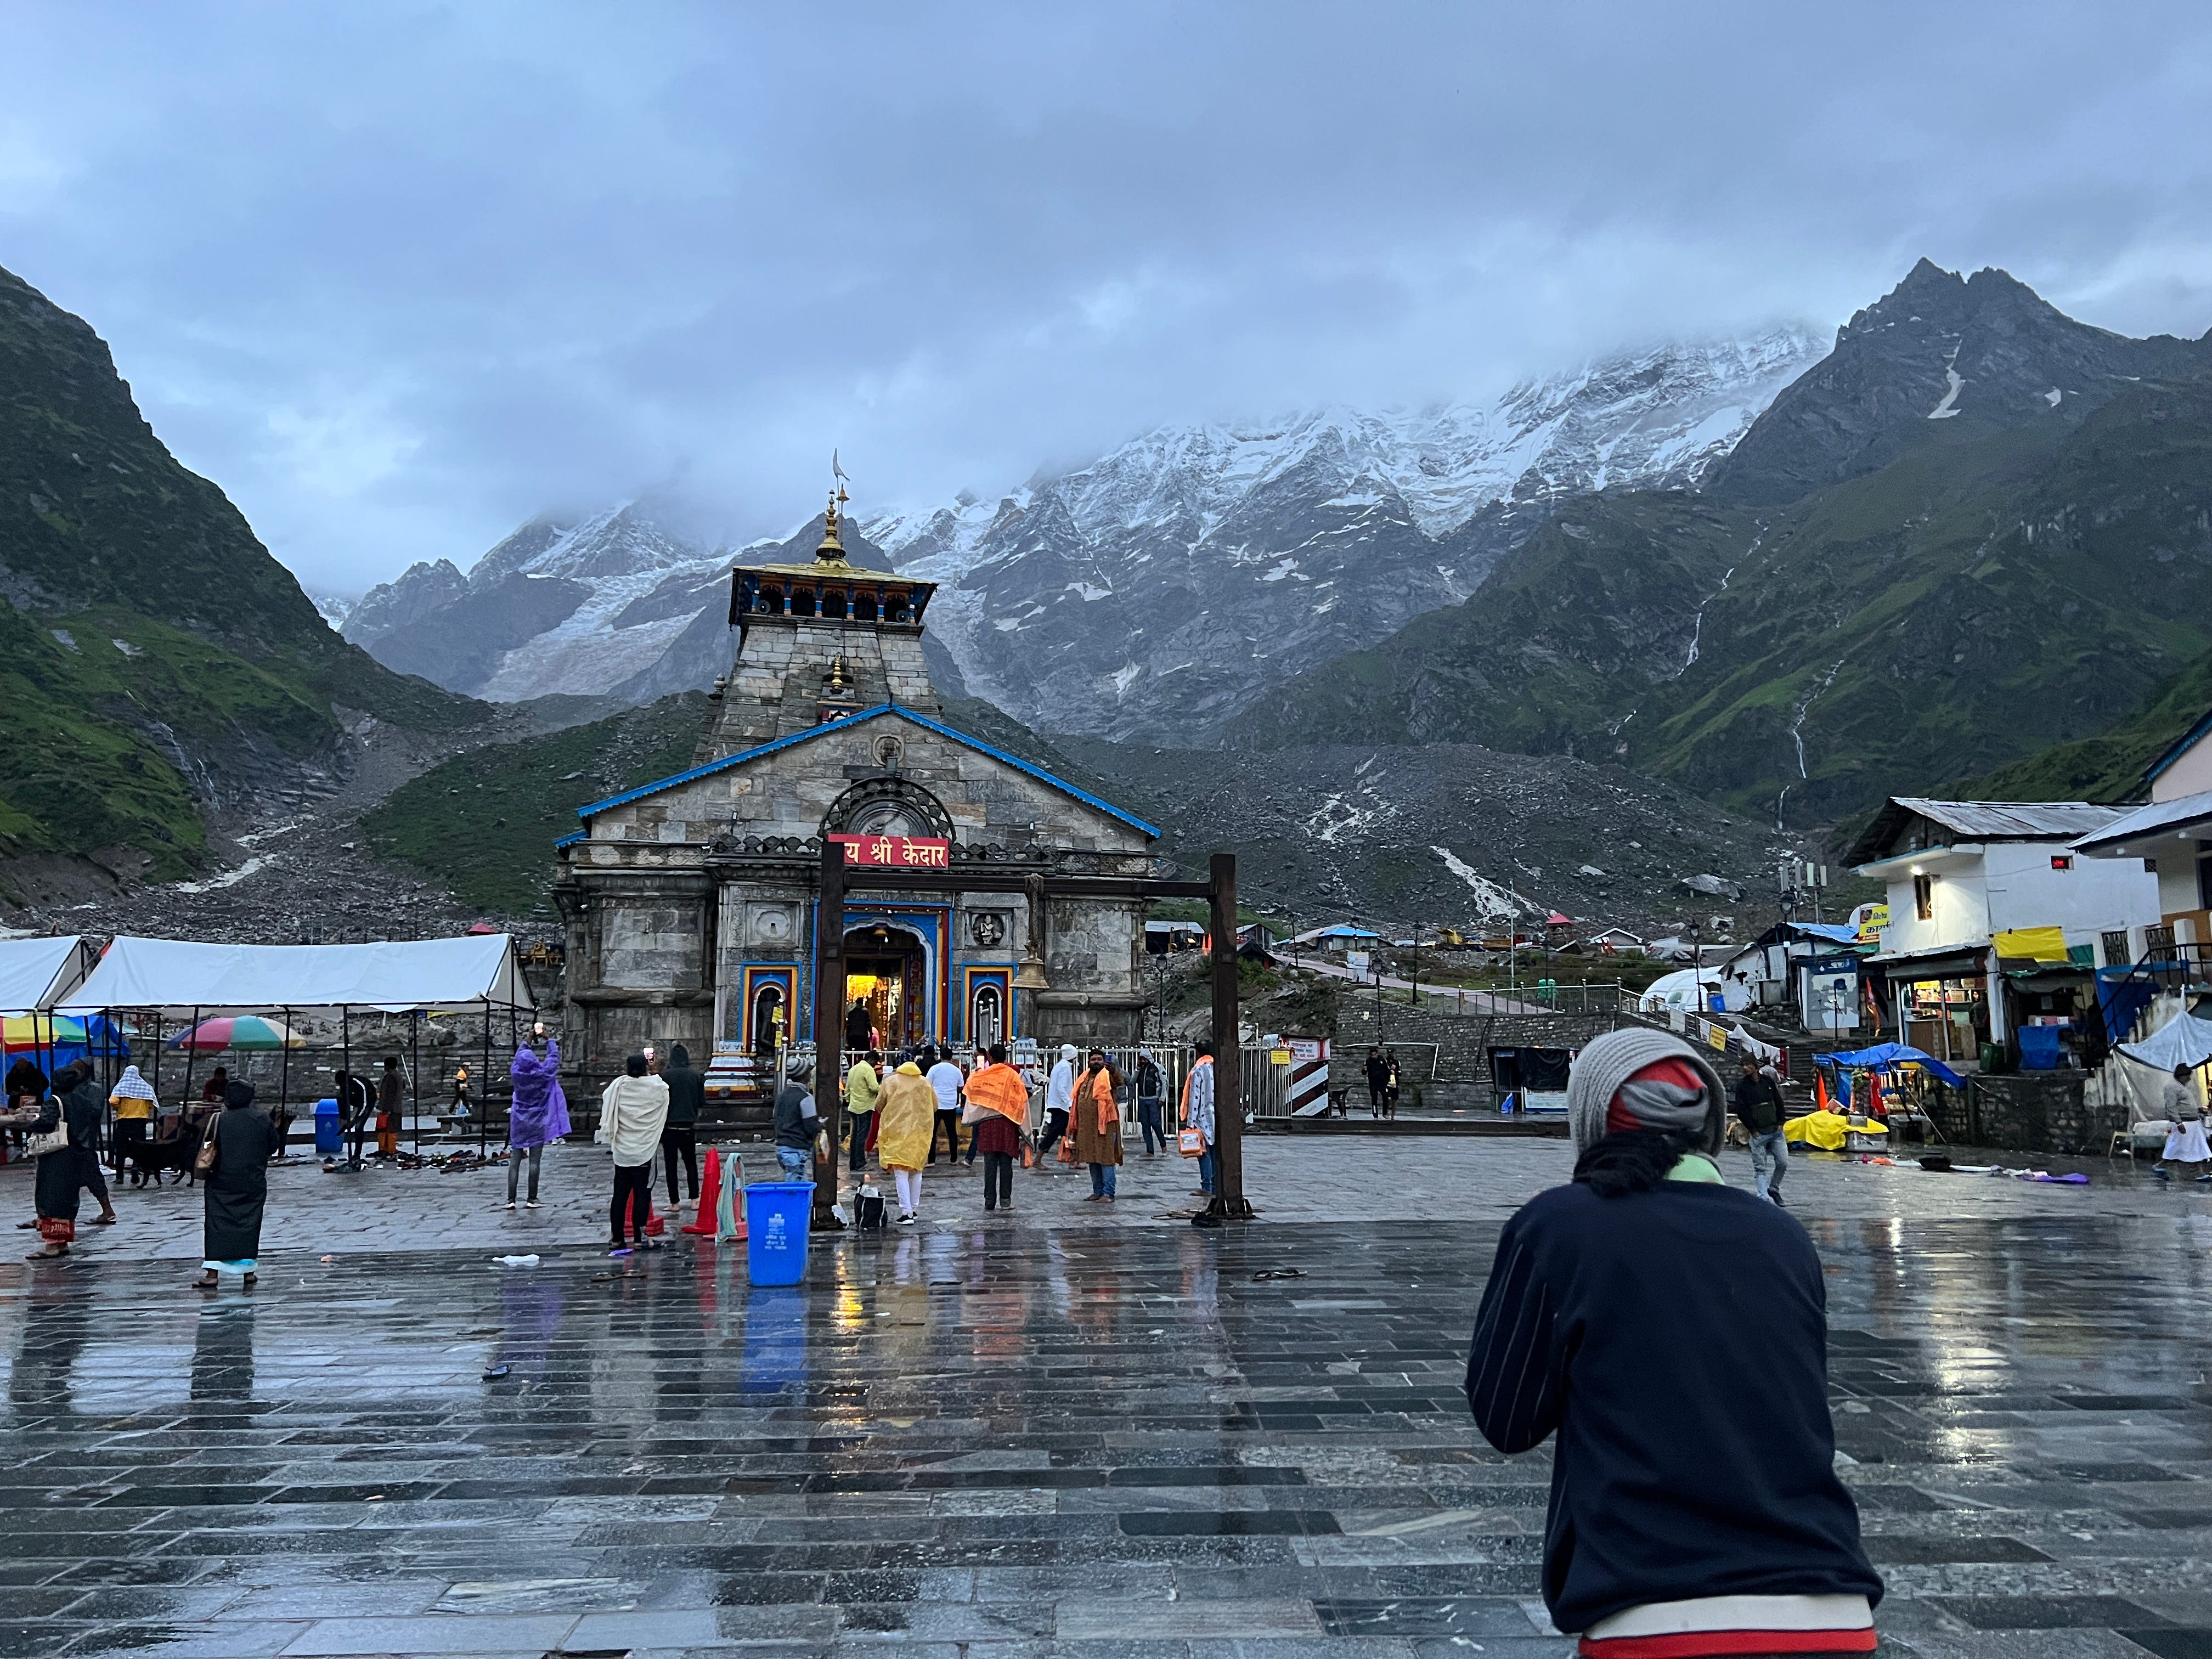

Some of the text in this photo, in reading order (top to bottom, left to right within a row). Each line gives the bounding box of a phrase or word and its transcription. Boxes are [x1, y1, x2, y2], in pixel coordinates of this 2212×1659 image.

[844, 836, 945, 867] य श्री केदार
